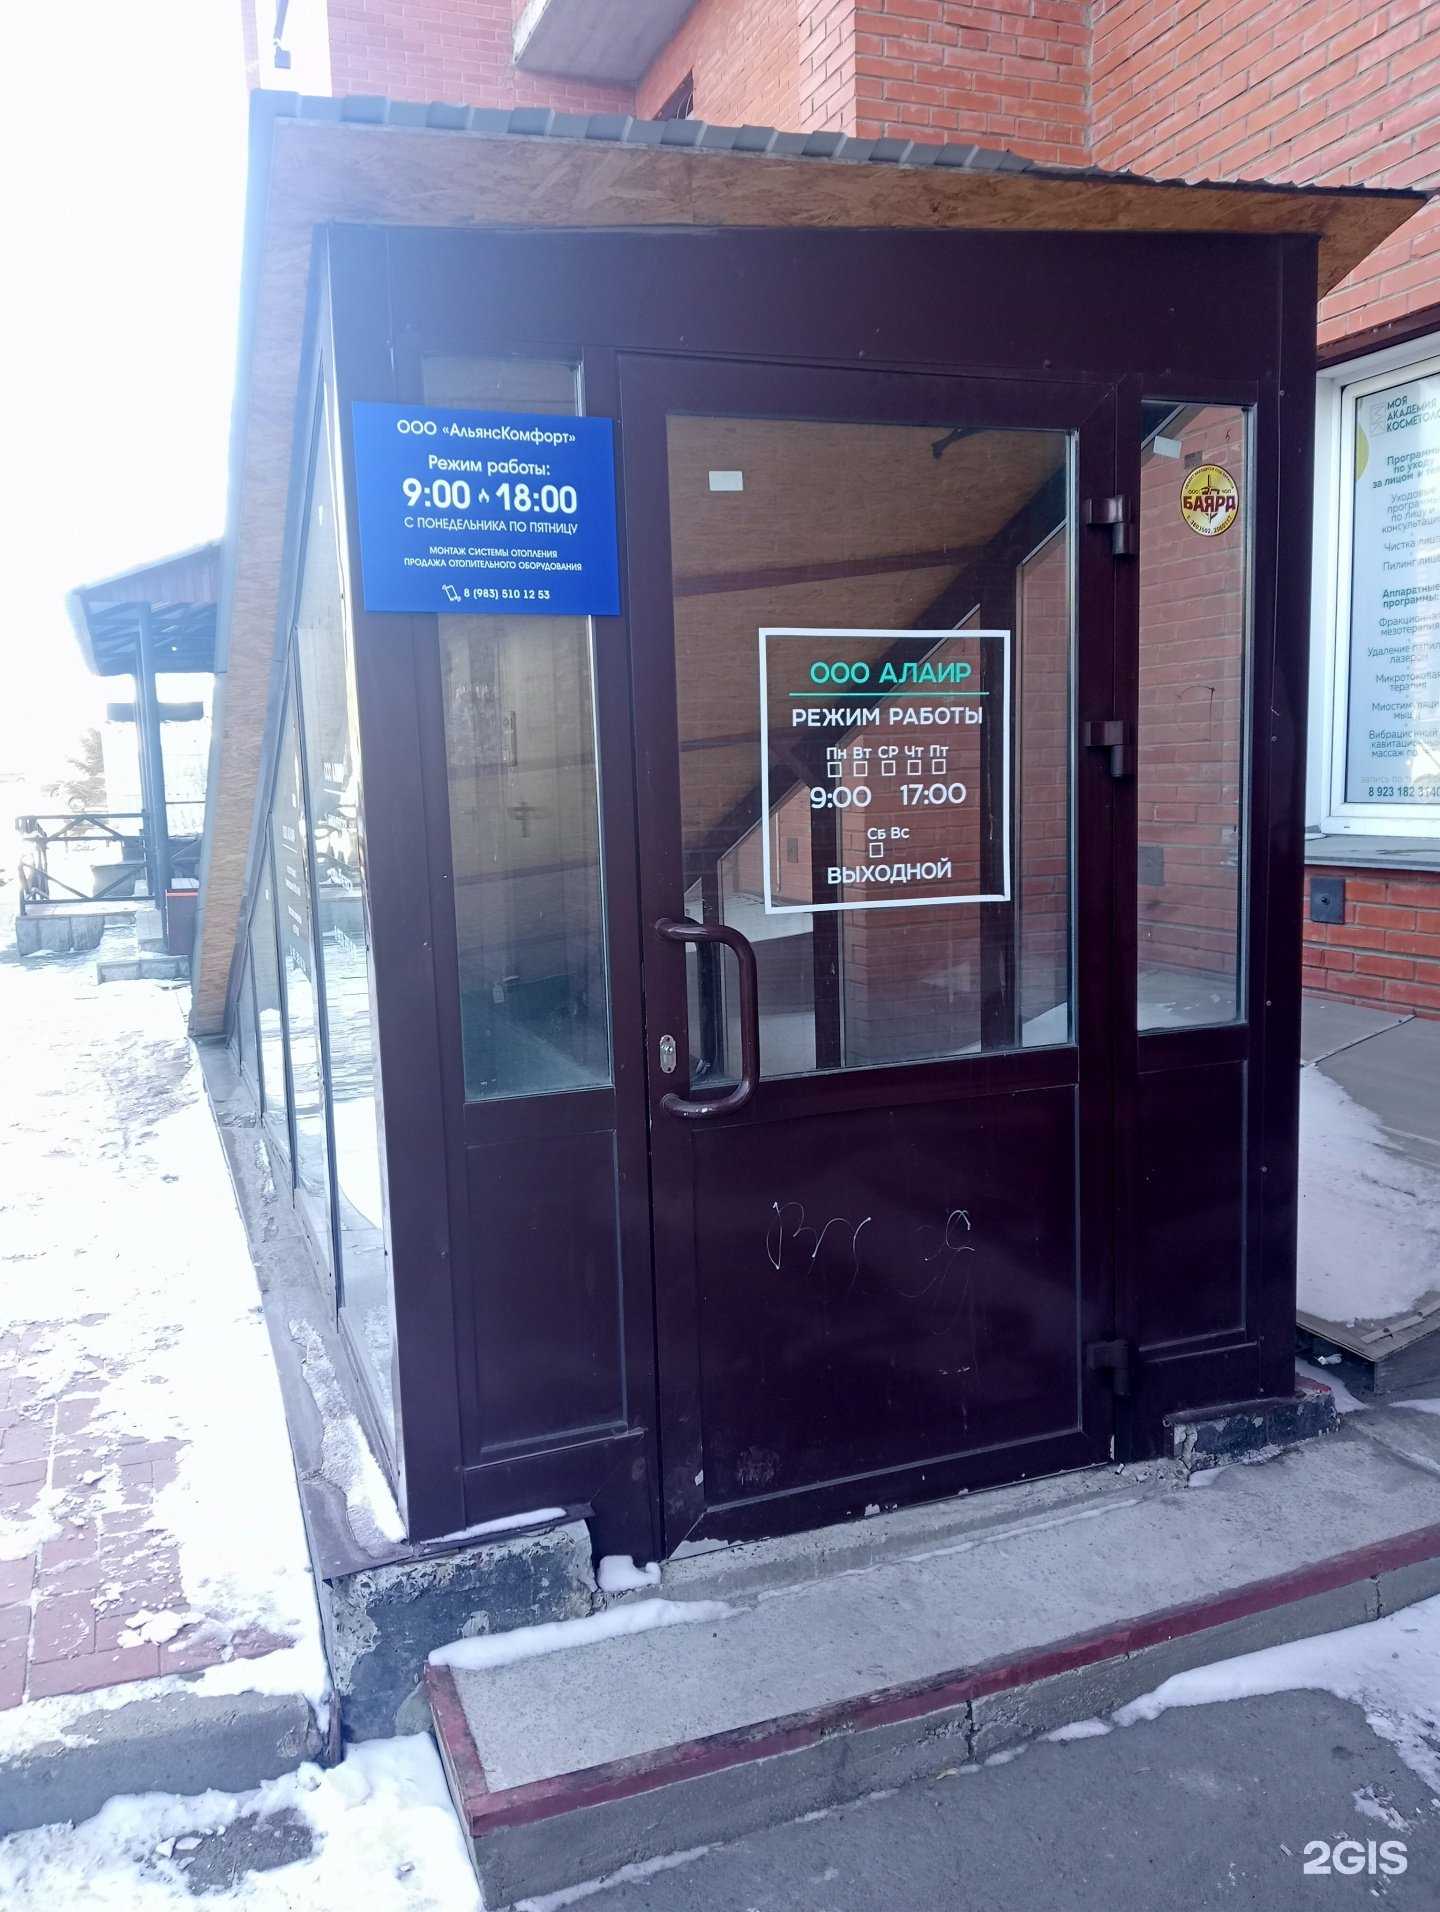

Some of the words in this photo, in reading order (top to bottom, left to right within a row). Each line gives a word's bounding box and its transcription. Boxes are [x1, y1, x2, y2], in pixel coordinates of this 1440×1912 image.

[1387, 395, 1408, 410] МОЯ
[396, 419, 437, 435] ООО
[442, 423, 576, 446] «АльянсКомфорт»
[428, 454, 483, 473] Режим
[487, 458, 551, 477] работы:
[1372, 480, 1383, 489] за
[1384, 473, 1414, 487] лицом
[401, 477, 472, 510] 9:00
[495, 482, 578, 514] 18:00
[1183, 495, 1236, 512] БАЯРД
[404, 517, 414, 528] С
[417, 517, 507, 531] ПОНЕДЕЛЬНИКА
[509, 521, 527, 533] ПО
[529, 521, 578, 536] ПЯТНИЦУ
[429, 546, 466, 556] МОНТАЖ
[468, 547, 508, 558] СИСТЕМЫ
[510, 549, 558, 559] ОТОПЛЕНИЯ
[1383, 540, 1416, 552] Чистка
[403, 557, 447, 568] ПРОДАЖА
[448, 559, 517, 570] ОТОПИТЕЛЬНОГО
[518, 561, 583, 572] ОБОРУДОВАНИЯ
[1383, 559, 1417, 571] Пилинг
[463, 588, 470, 598] 8
[473, 588, 499, 600] (983)
[501, 589, 520, 599] 510
[523, 589, 535, 600] 12
[537, 590, 550, 600] 53
[810, 661, 870, 684] ООО
[878, 662, 972, 684] АЛАИР
[791, 708, 880, 727] РЕЖИМ
[889, 706, 983, 725] РАБОТЫ
[826, 747, 847, 760] Пн
[852, 746, 872, 759] Вт
[904, 745, 924, 758] Чт
[929, 744, 949, 757] Пт
[810, 786, 872, 809] 9:00
[900, 782, 967, 806] 17:00
[1367, 786, 1375, 797] 8
[1377, 786, 1394, 797] 923
[1397, 786, 1415, 797] 182
[867, 827, 887, 840] Сб
[890, 827, 911, 839] Вс
[826, 857, 952, 885] ВЫХОДНОЙ
